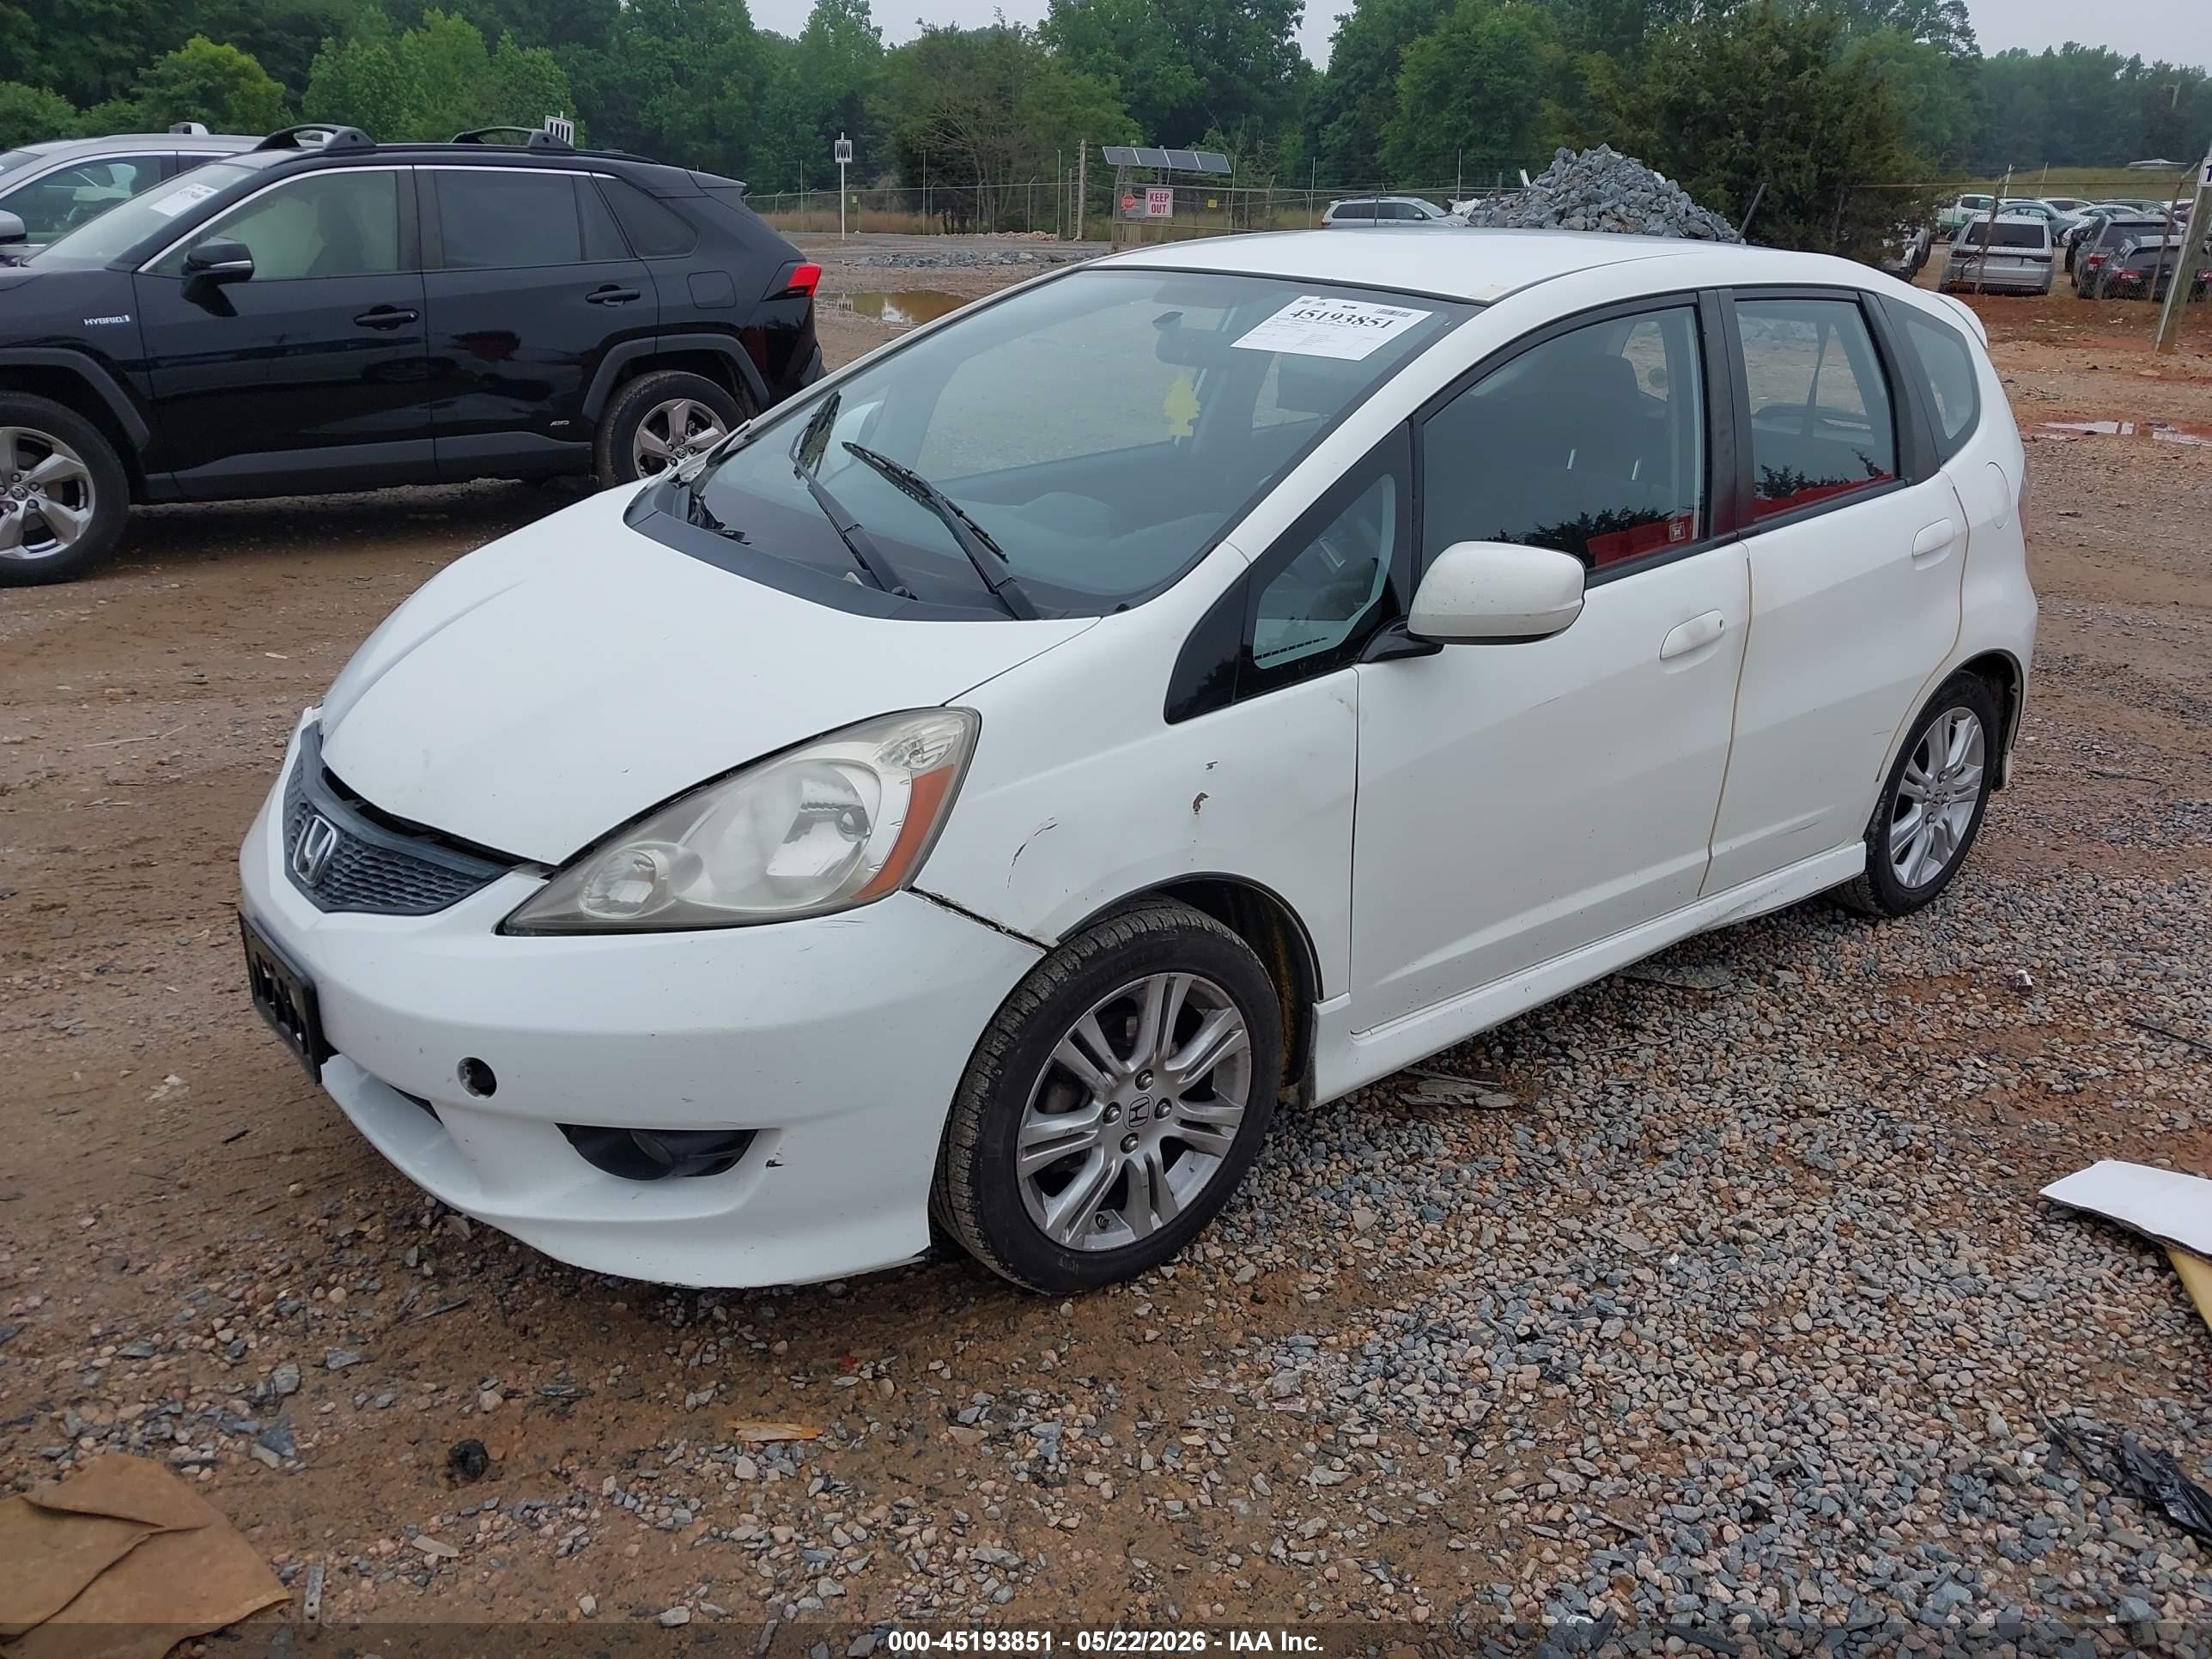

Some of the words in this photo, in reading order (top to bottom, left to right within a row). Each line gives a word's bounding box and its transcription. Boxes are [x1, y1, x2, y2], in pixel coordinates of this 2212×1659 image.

[1149, 191, 1170, 203] KEEP
[1151, 204, 1167, 214] OUT
[82, 316, 123, 325] HYBRID
[1289, 307, 1395, 329] 45193851
